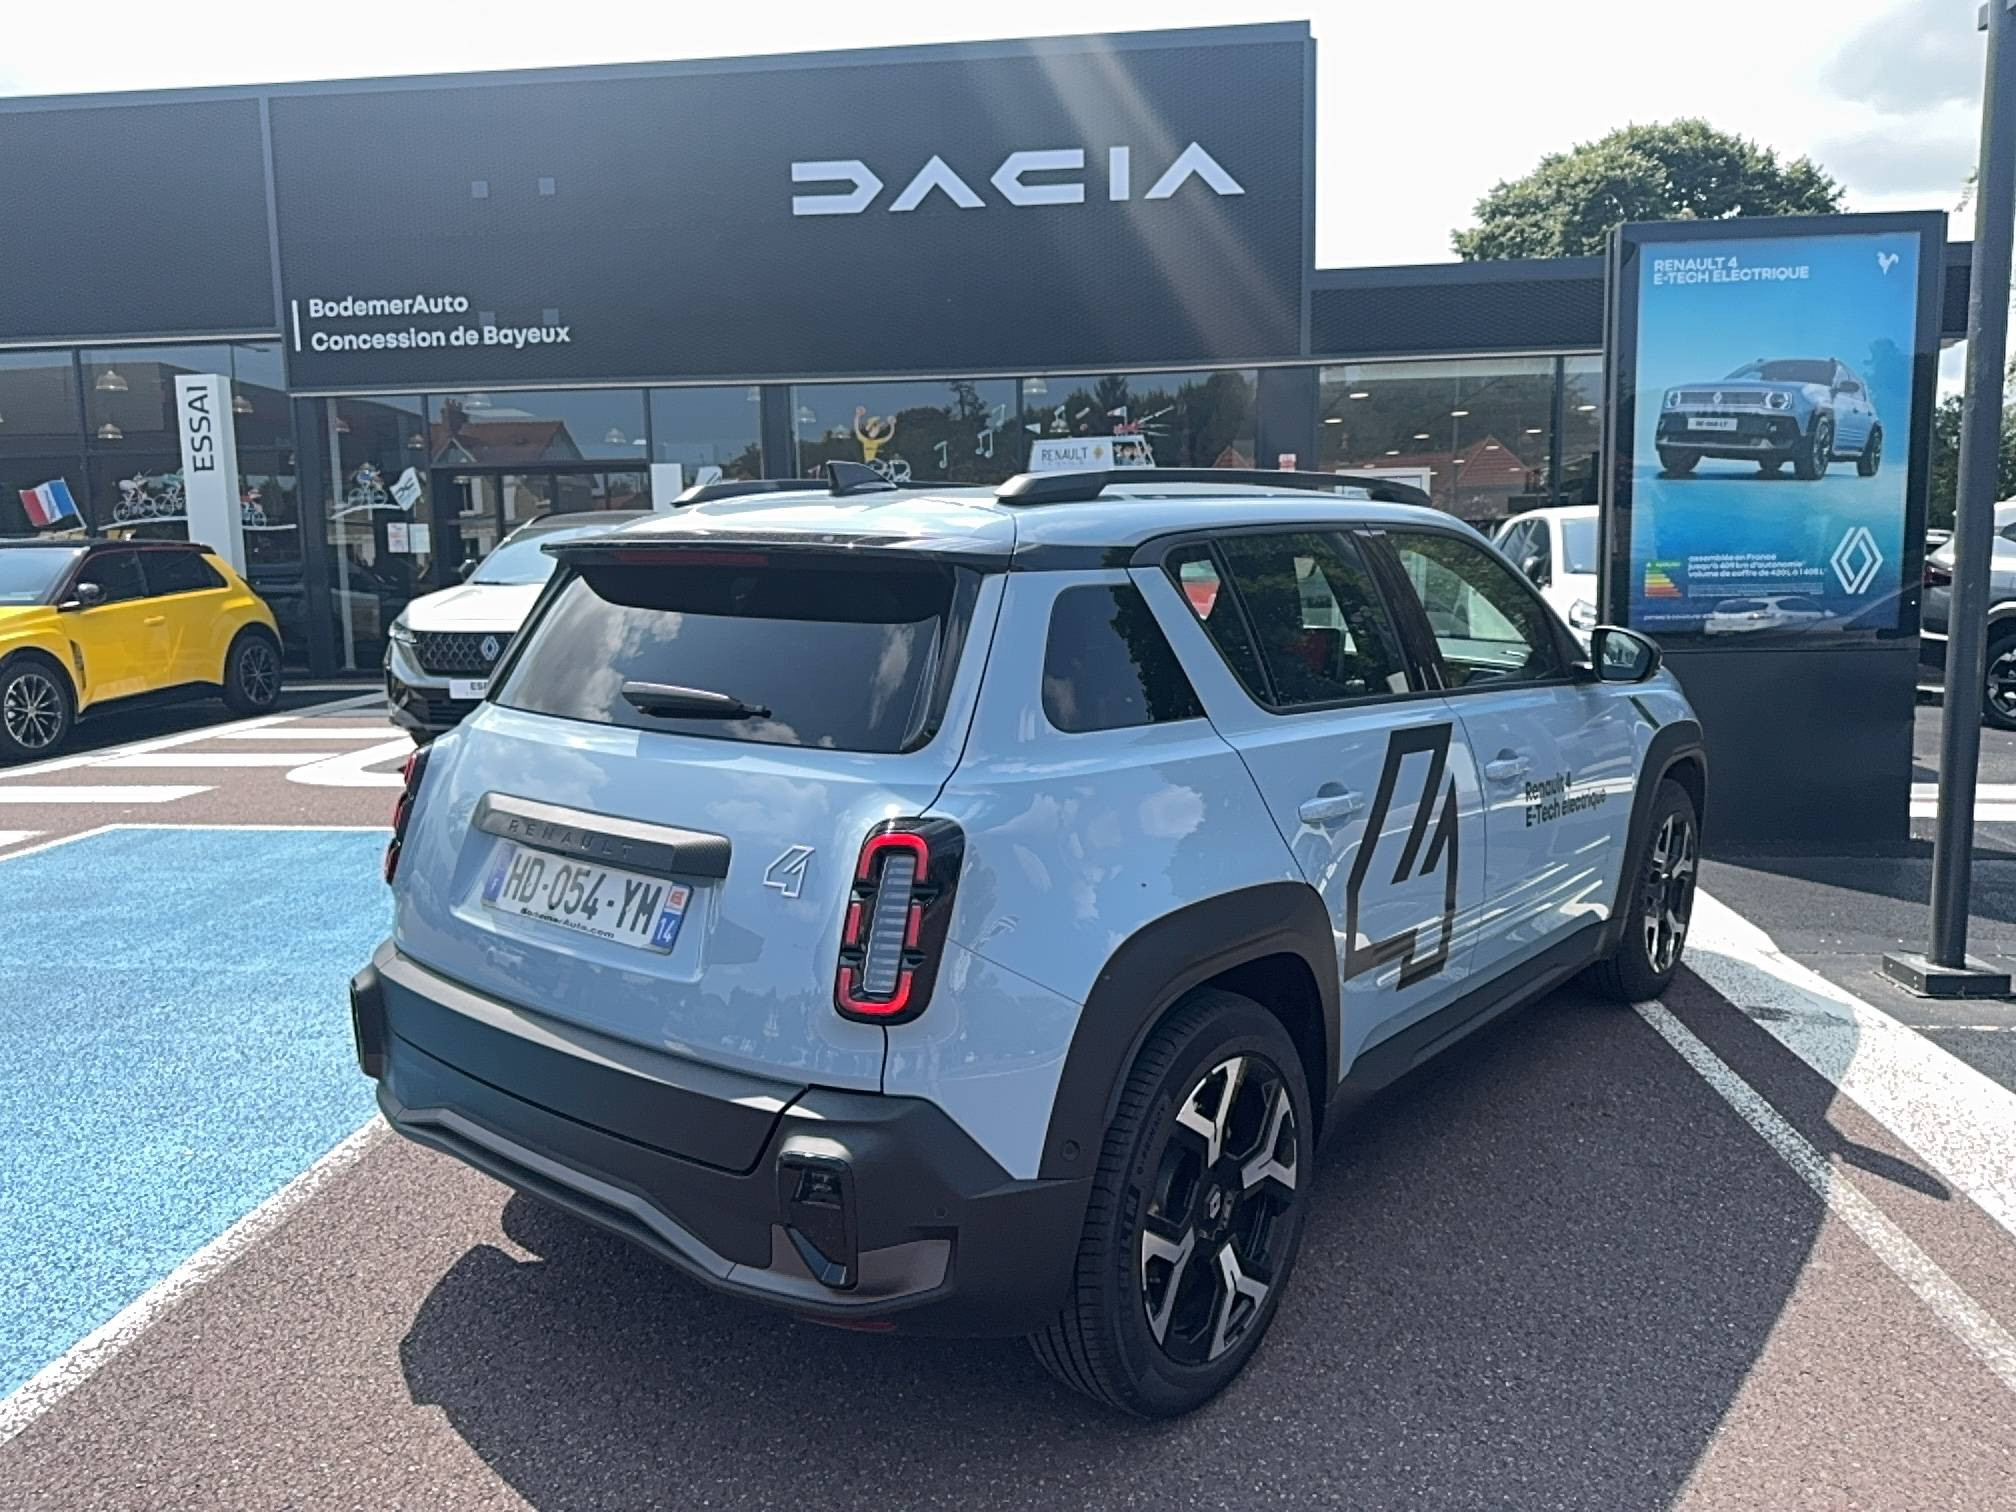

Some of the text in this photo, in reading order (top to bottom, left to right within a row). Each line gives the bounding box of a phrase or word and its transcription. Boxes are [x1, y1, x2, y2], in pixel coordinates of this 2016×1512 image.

[791, 141, 1246, 216] DACIA
[1653, 256, 1738, 272] RENAULT 4
[1653, 271, 1709, 285] E-TECH
[309, 295, 469, 317] BodemerAuto
[311, 325, 571, 351] Concession de Bayeux
[186, 386, 215, 472] ESSAI
[1041, 446, 1089, 461] RENAULT
[1525, 773, 1564, 802] Renault
[1525, 798, 1560, 827] E-Tech
[508, 819, 633, 859] RENAULT
[657, 917, 677, 943] 14
